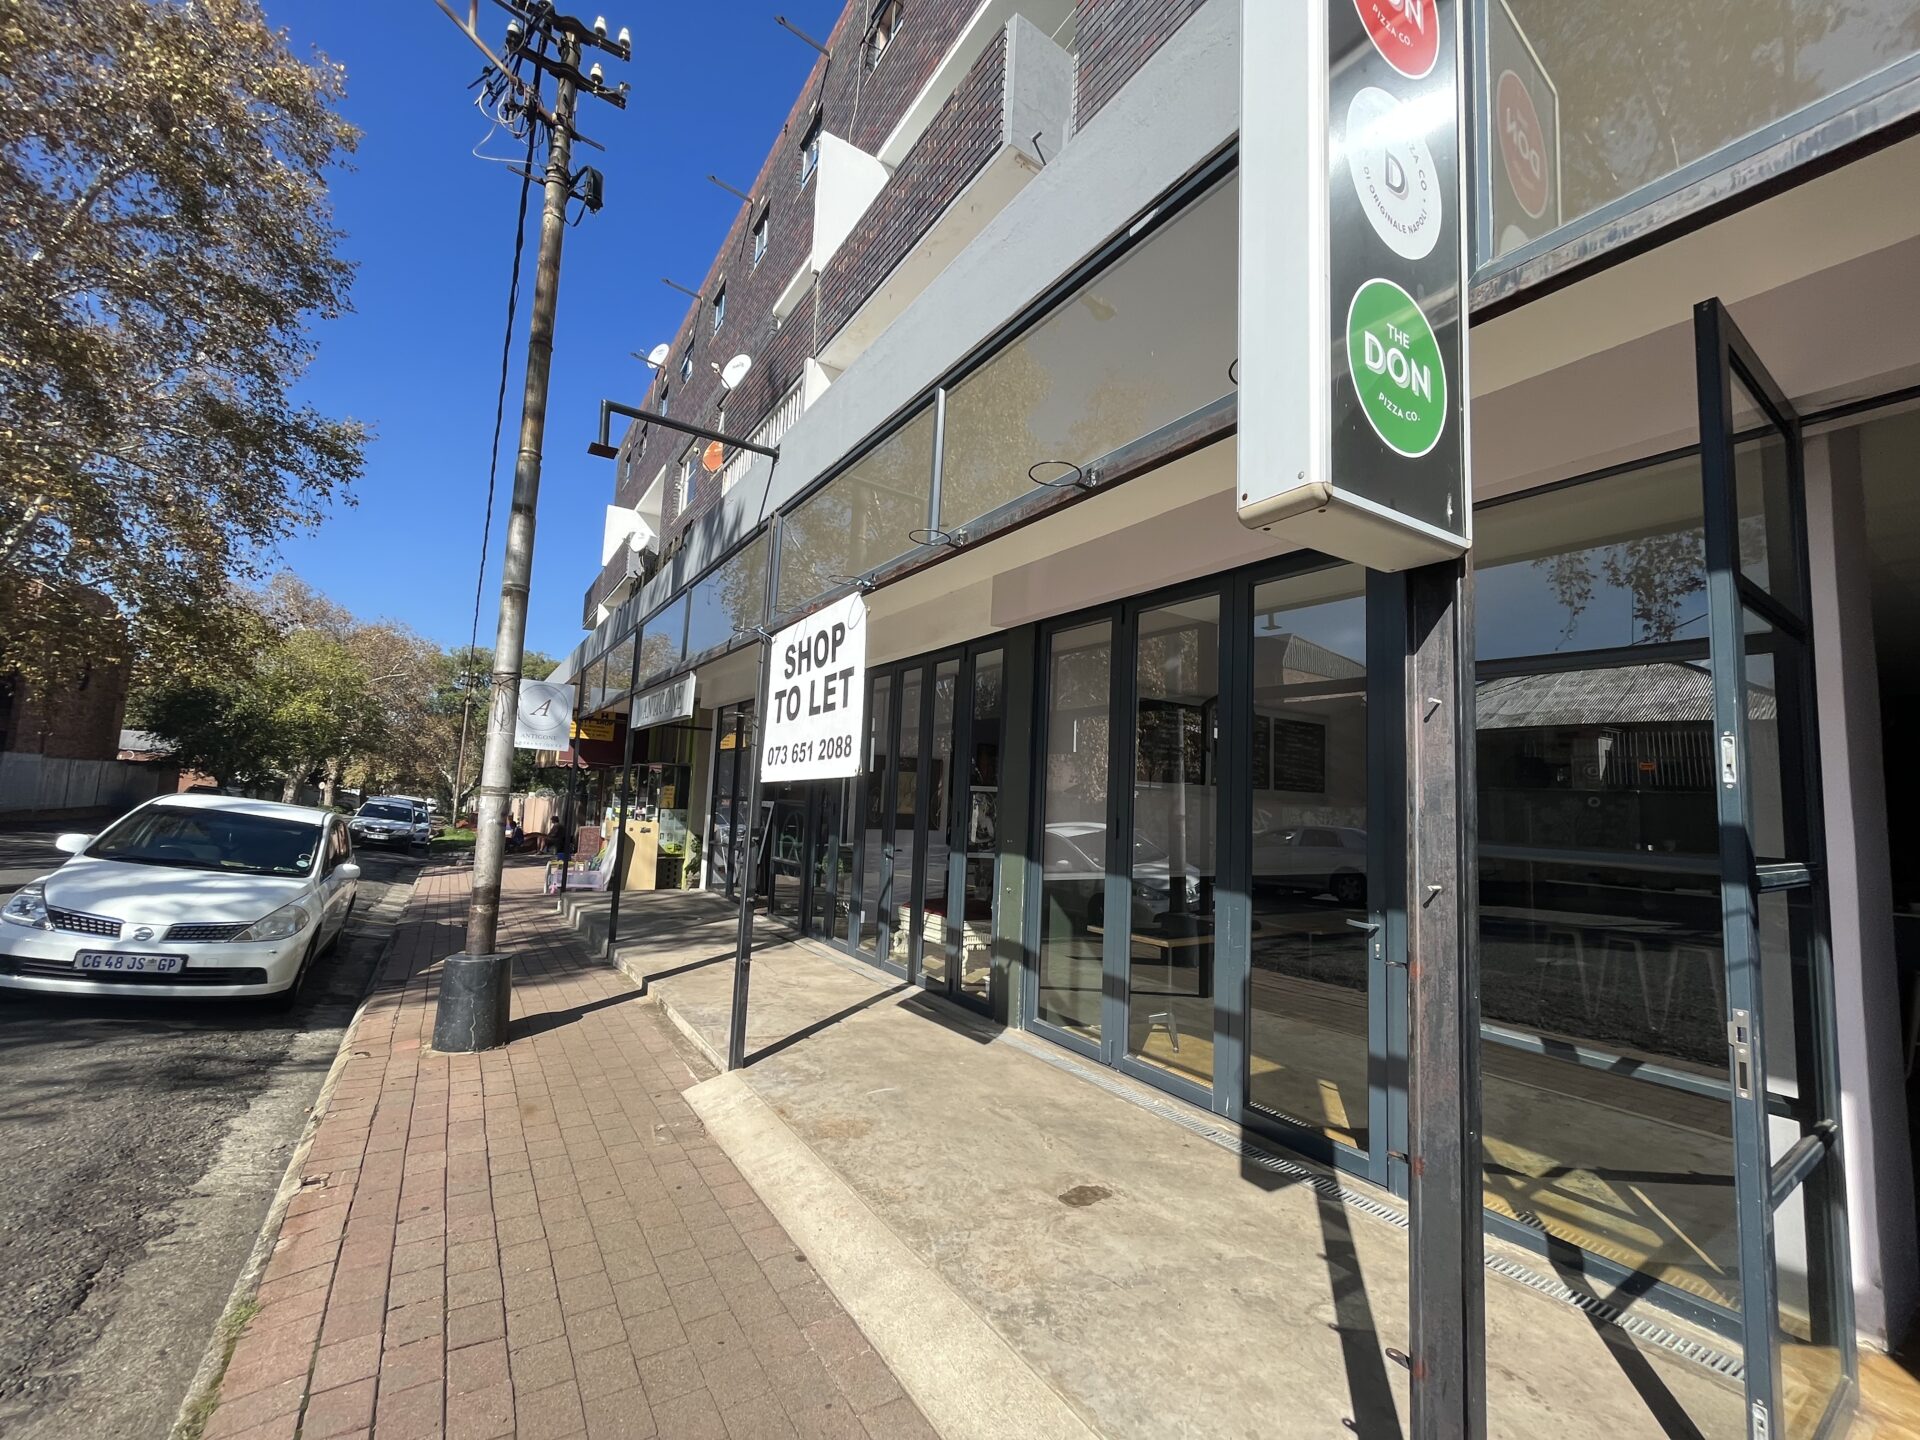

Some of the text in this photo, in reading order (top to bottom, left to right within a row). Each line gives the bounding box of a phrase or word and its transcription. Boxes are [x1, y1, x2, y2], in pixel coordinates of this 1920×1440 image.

[1372, 3, 1397, 38] PIZZA
[1385, 147, 1409, 200] D
[1369, 184, 1407, 234] ORIGINALE
[1407, 208, 1427, 234] NAPOLI
[1386, 323, 1410, 350] THE
[1364, 330, 1432, 403] DON
[1378, 392, 1421, 422] PIZZA CO.
[784, 621, 846, 680] SHOP
[529, 699, 552, 717] A
[774, 666, 855, 724] TO LET
[767, 734, 852, 766] 073 651 2088
[82, 954, 176, 972] CG 48 JS GP
